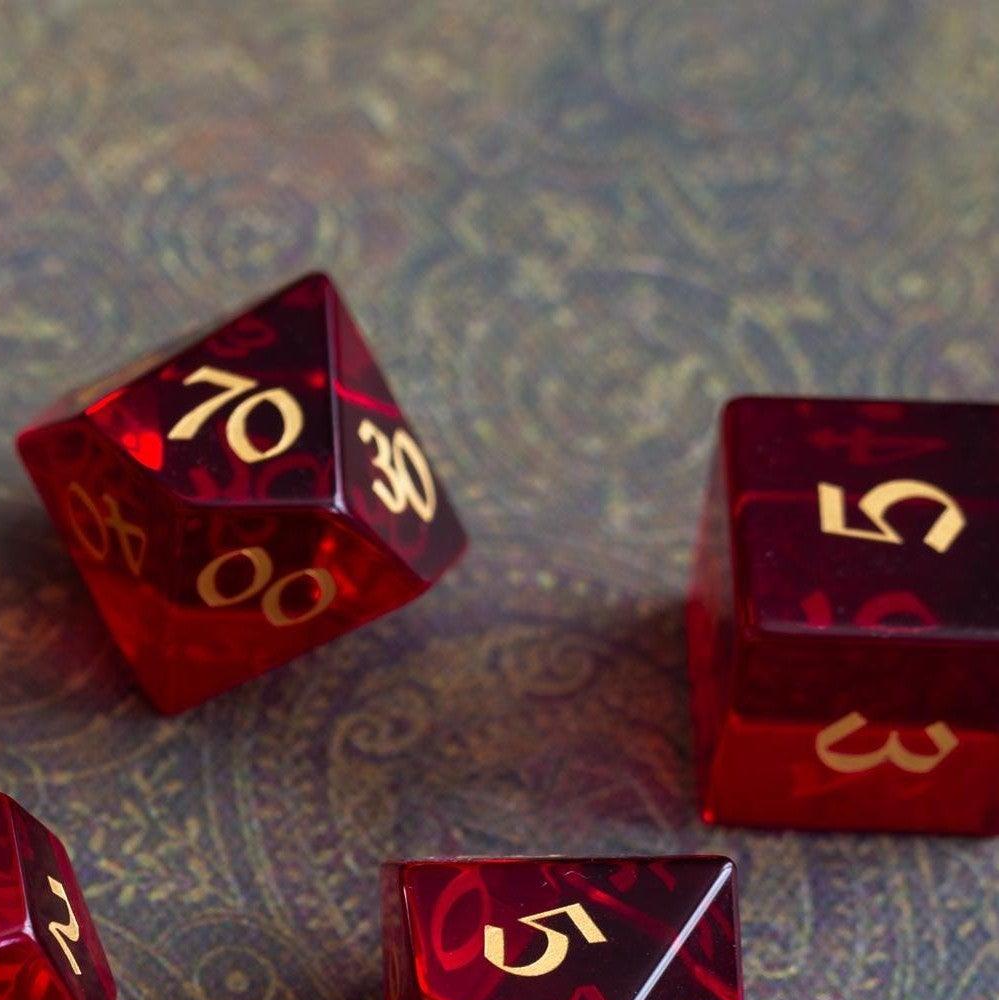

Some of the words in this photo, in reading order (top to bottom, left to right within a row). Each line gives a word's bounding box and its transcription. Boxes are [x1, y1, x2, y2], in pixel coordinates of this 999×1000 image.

[167, 366, 304, 464] 70
[357, 418, 438, 523] 30
[816, 478, 967, 555] 5
[196, 546, 338, 627] 00
[815, 711, 960, 774] 3
[47, 875, 81, 976] 2
[483, 902, 608, 978] 5
